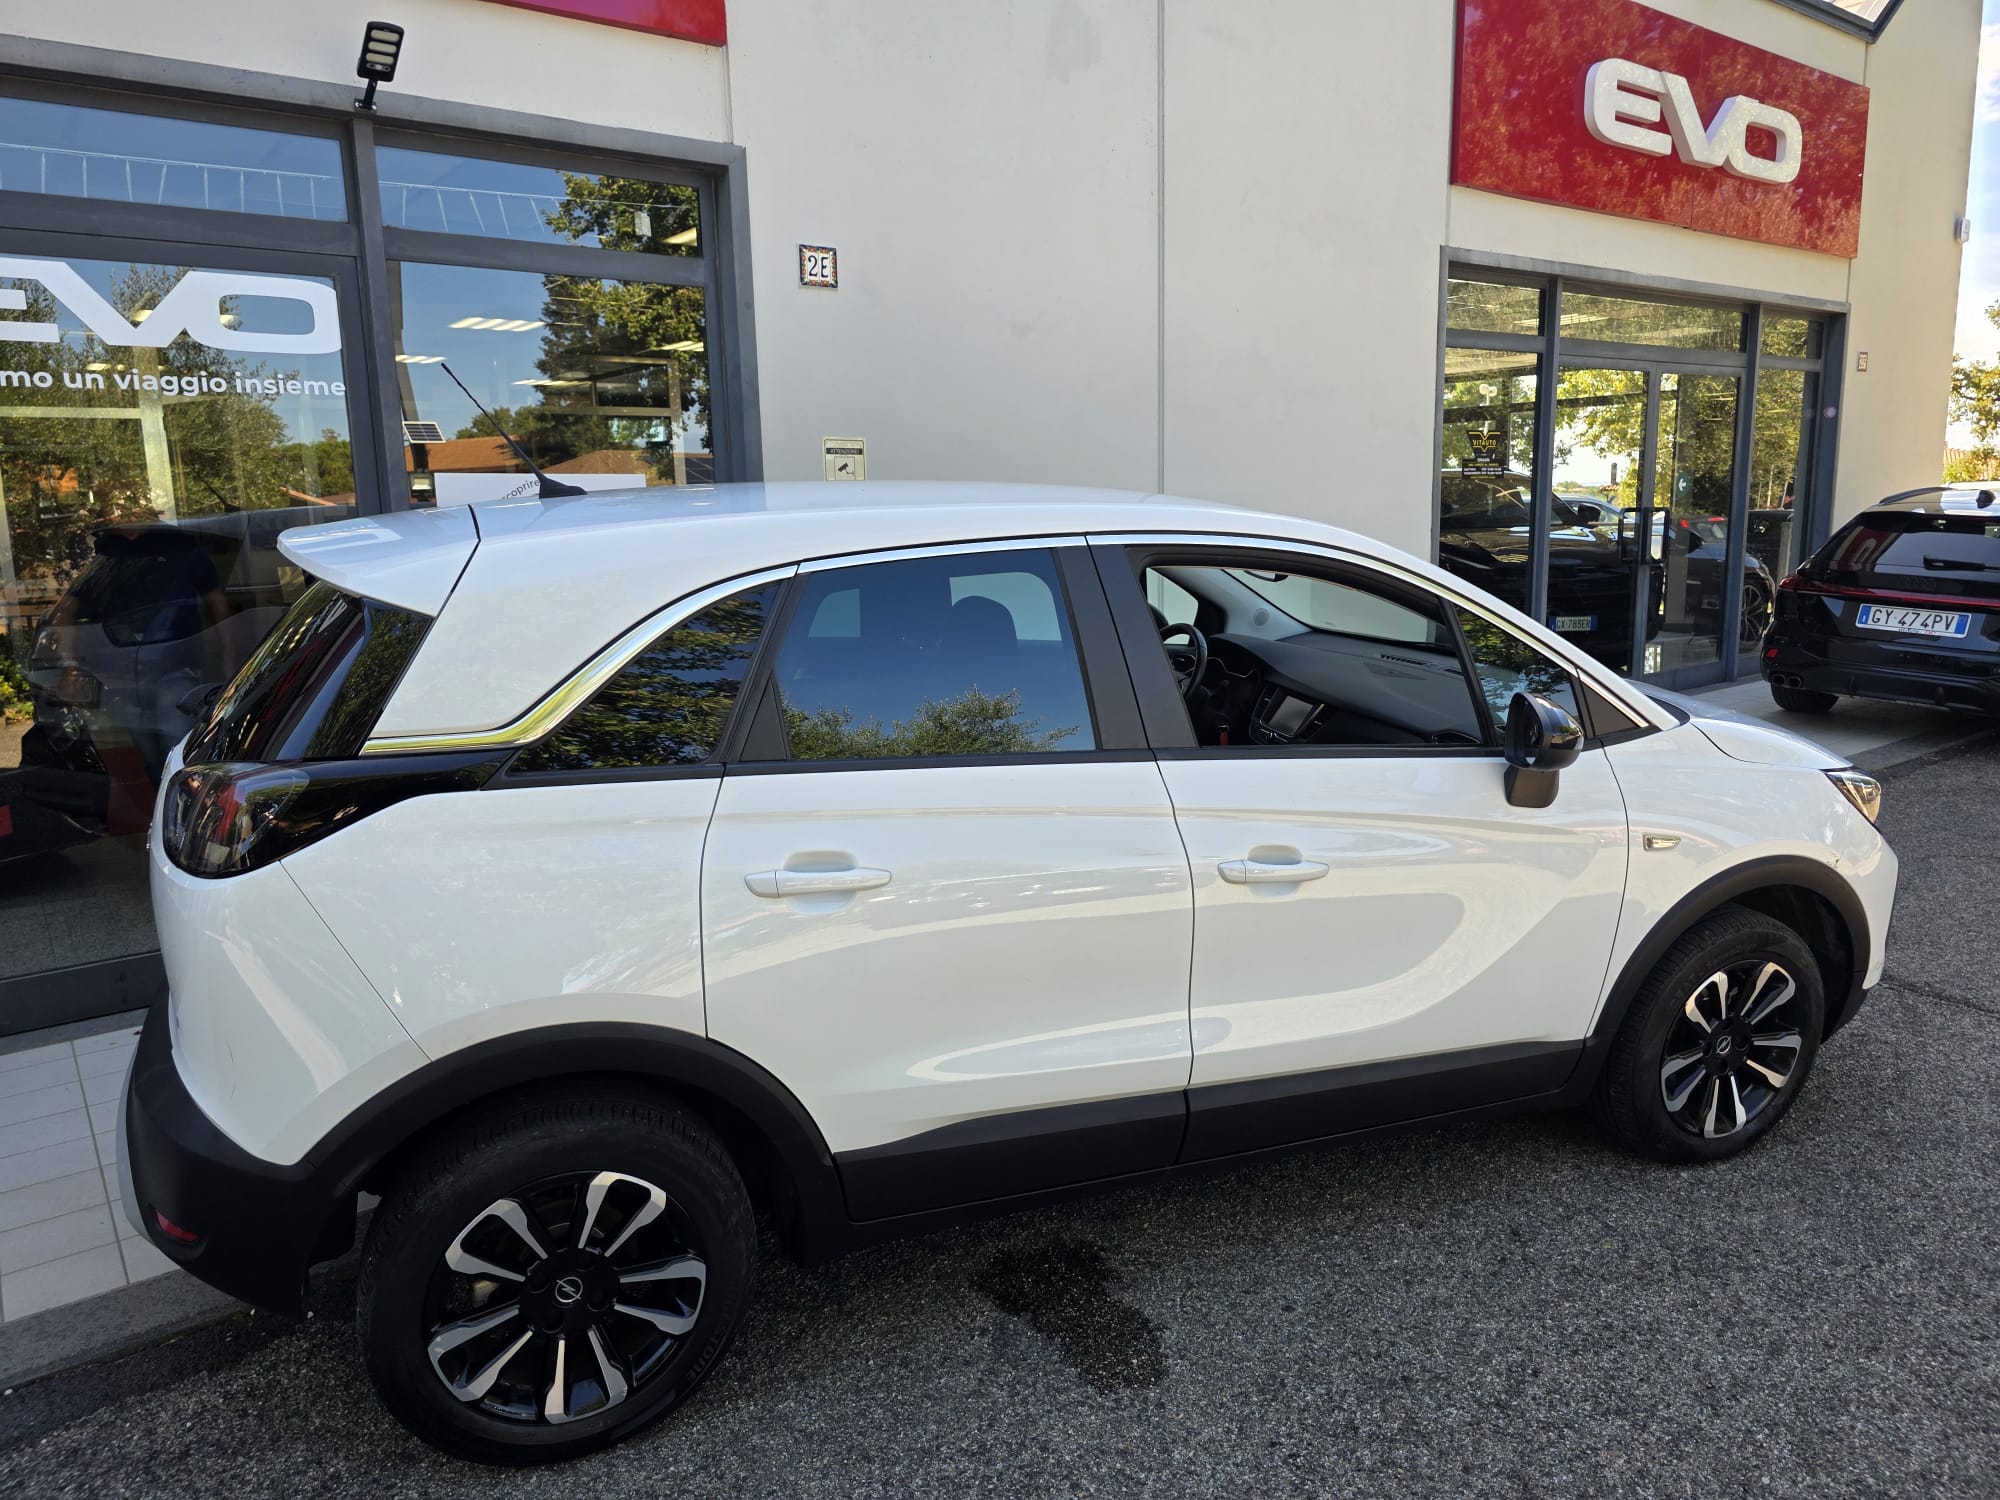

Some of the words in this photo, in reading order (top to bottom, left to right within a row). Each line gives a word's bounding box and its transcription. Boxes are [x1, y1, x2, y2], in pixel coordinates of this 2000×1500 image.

[1584, 58, 1803, 184] EVO
[807, 255, 829, 278] 2E
[63, 372, 104, 390] un
[113, 368, 227, 396] viaggio
[236, 371, 346, 396] insieme
